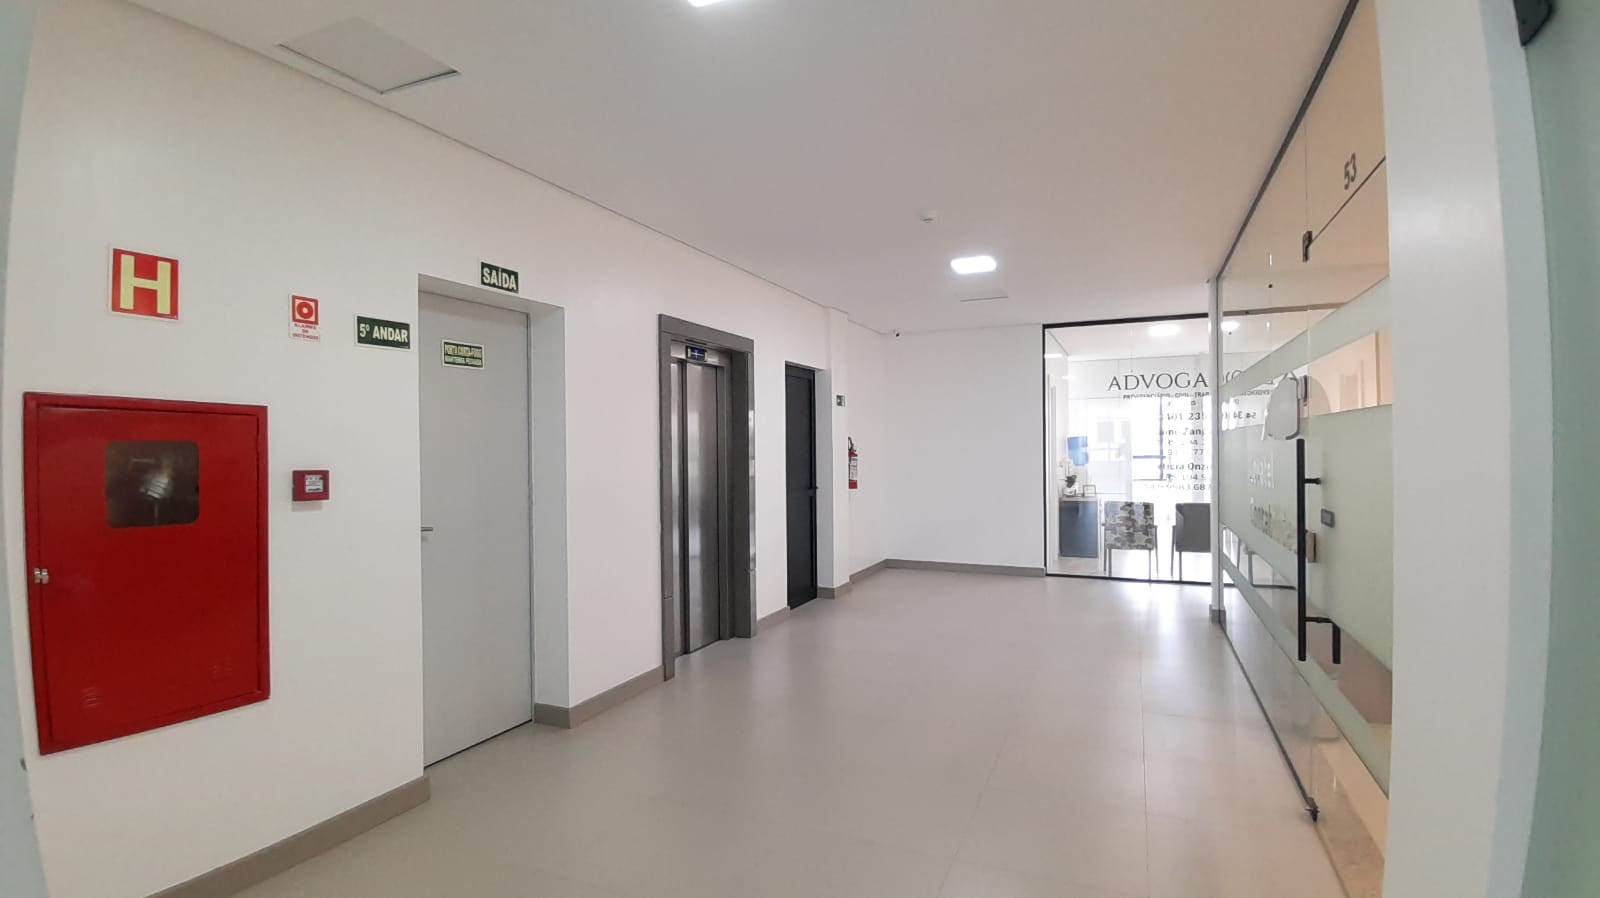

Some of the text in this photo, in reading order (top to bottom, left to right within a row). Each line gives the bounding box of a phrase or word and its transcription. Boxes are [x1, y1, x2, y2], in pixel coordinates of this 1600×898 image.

[1344, 152, 1357, 190] 53
[120, 253, 171, 315] H
[482, 267, 517, 291] SAÍDA
[372, 325, 408, 343] ANDAR
